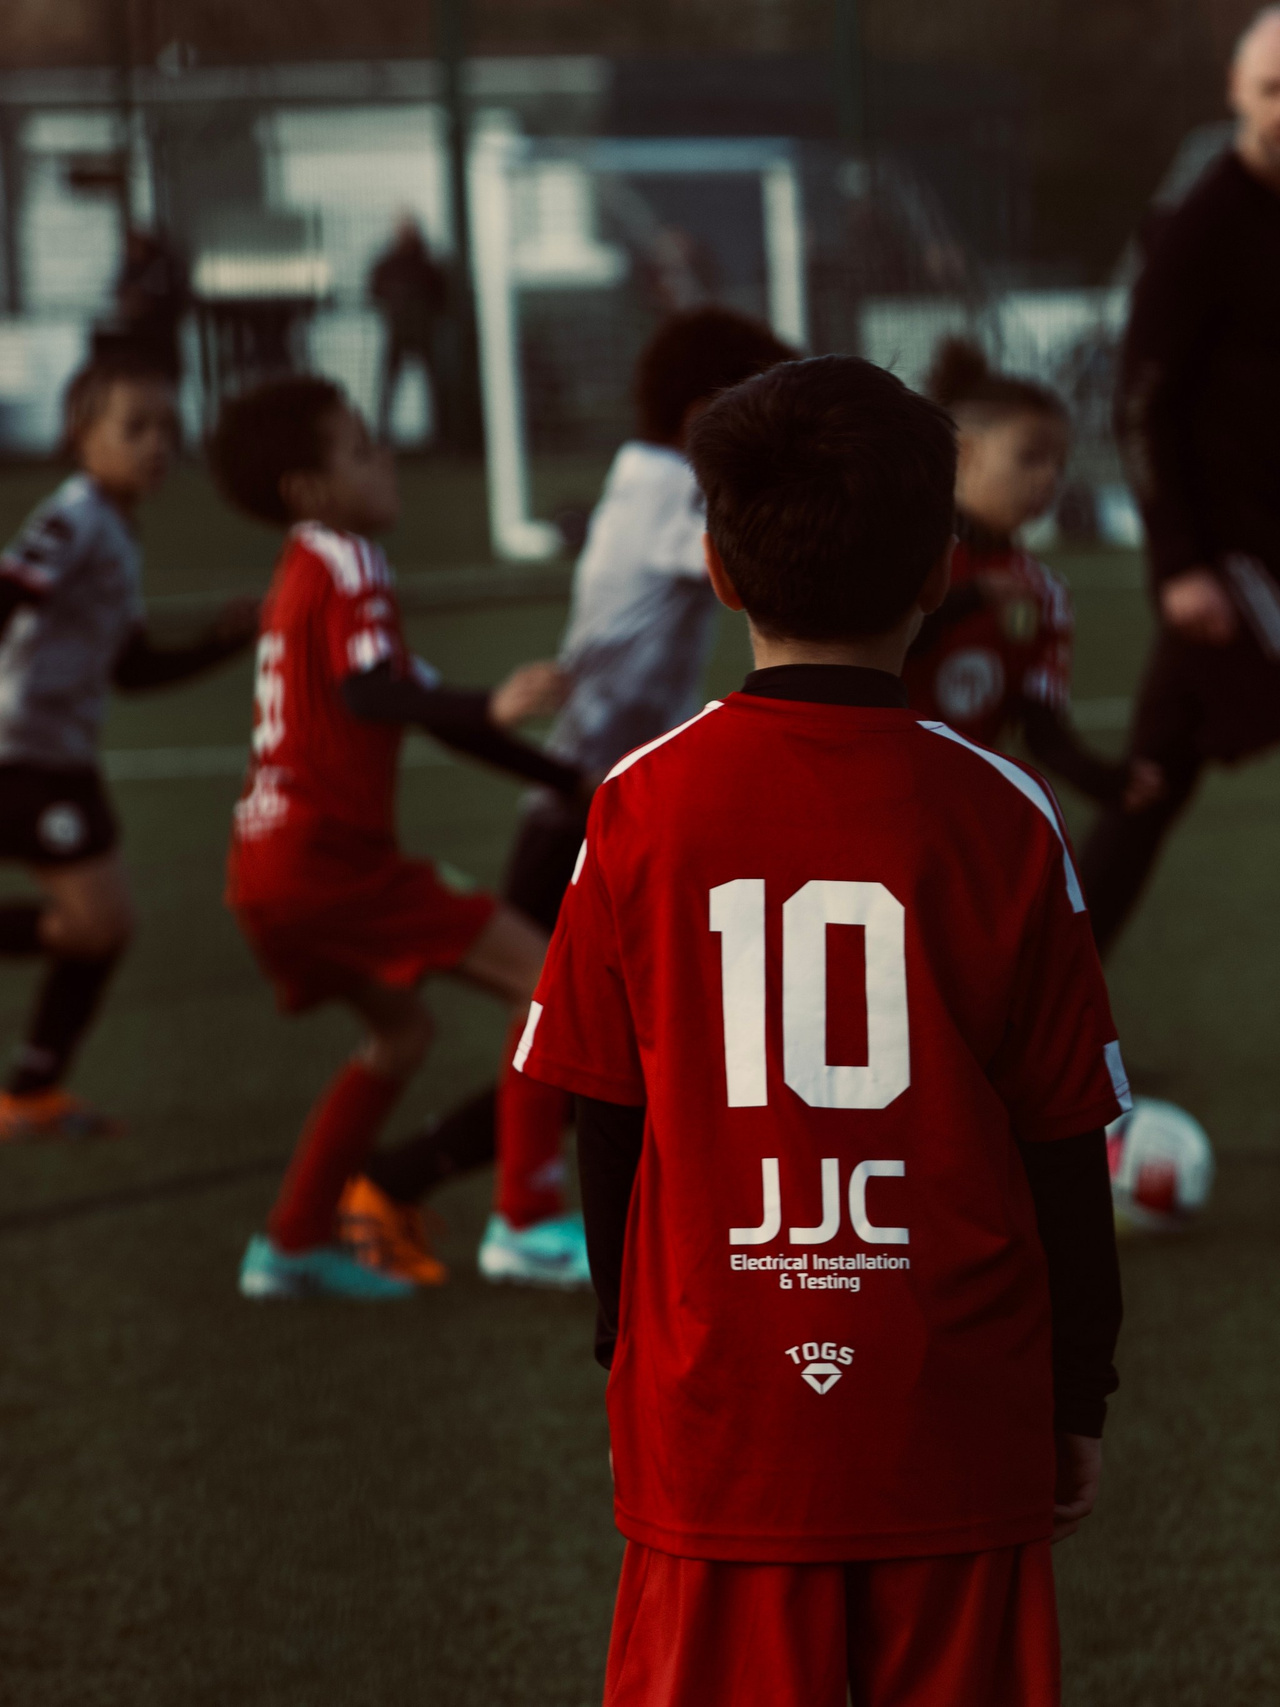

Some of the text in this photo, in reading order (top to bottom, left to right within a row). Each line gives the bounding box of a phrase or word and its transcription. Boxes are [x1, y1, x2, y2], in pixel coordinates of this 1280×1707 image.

[708, 878, 911, 1110] 10
[729, 1157, 910, 1245] JJC
[730, 1253, 910, 1271] Electrical Installation
[779, 1272, 861, 1292] & Testing
[784, 1341, 855, 1366] TOGS
